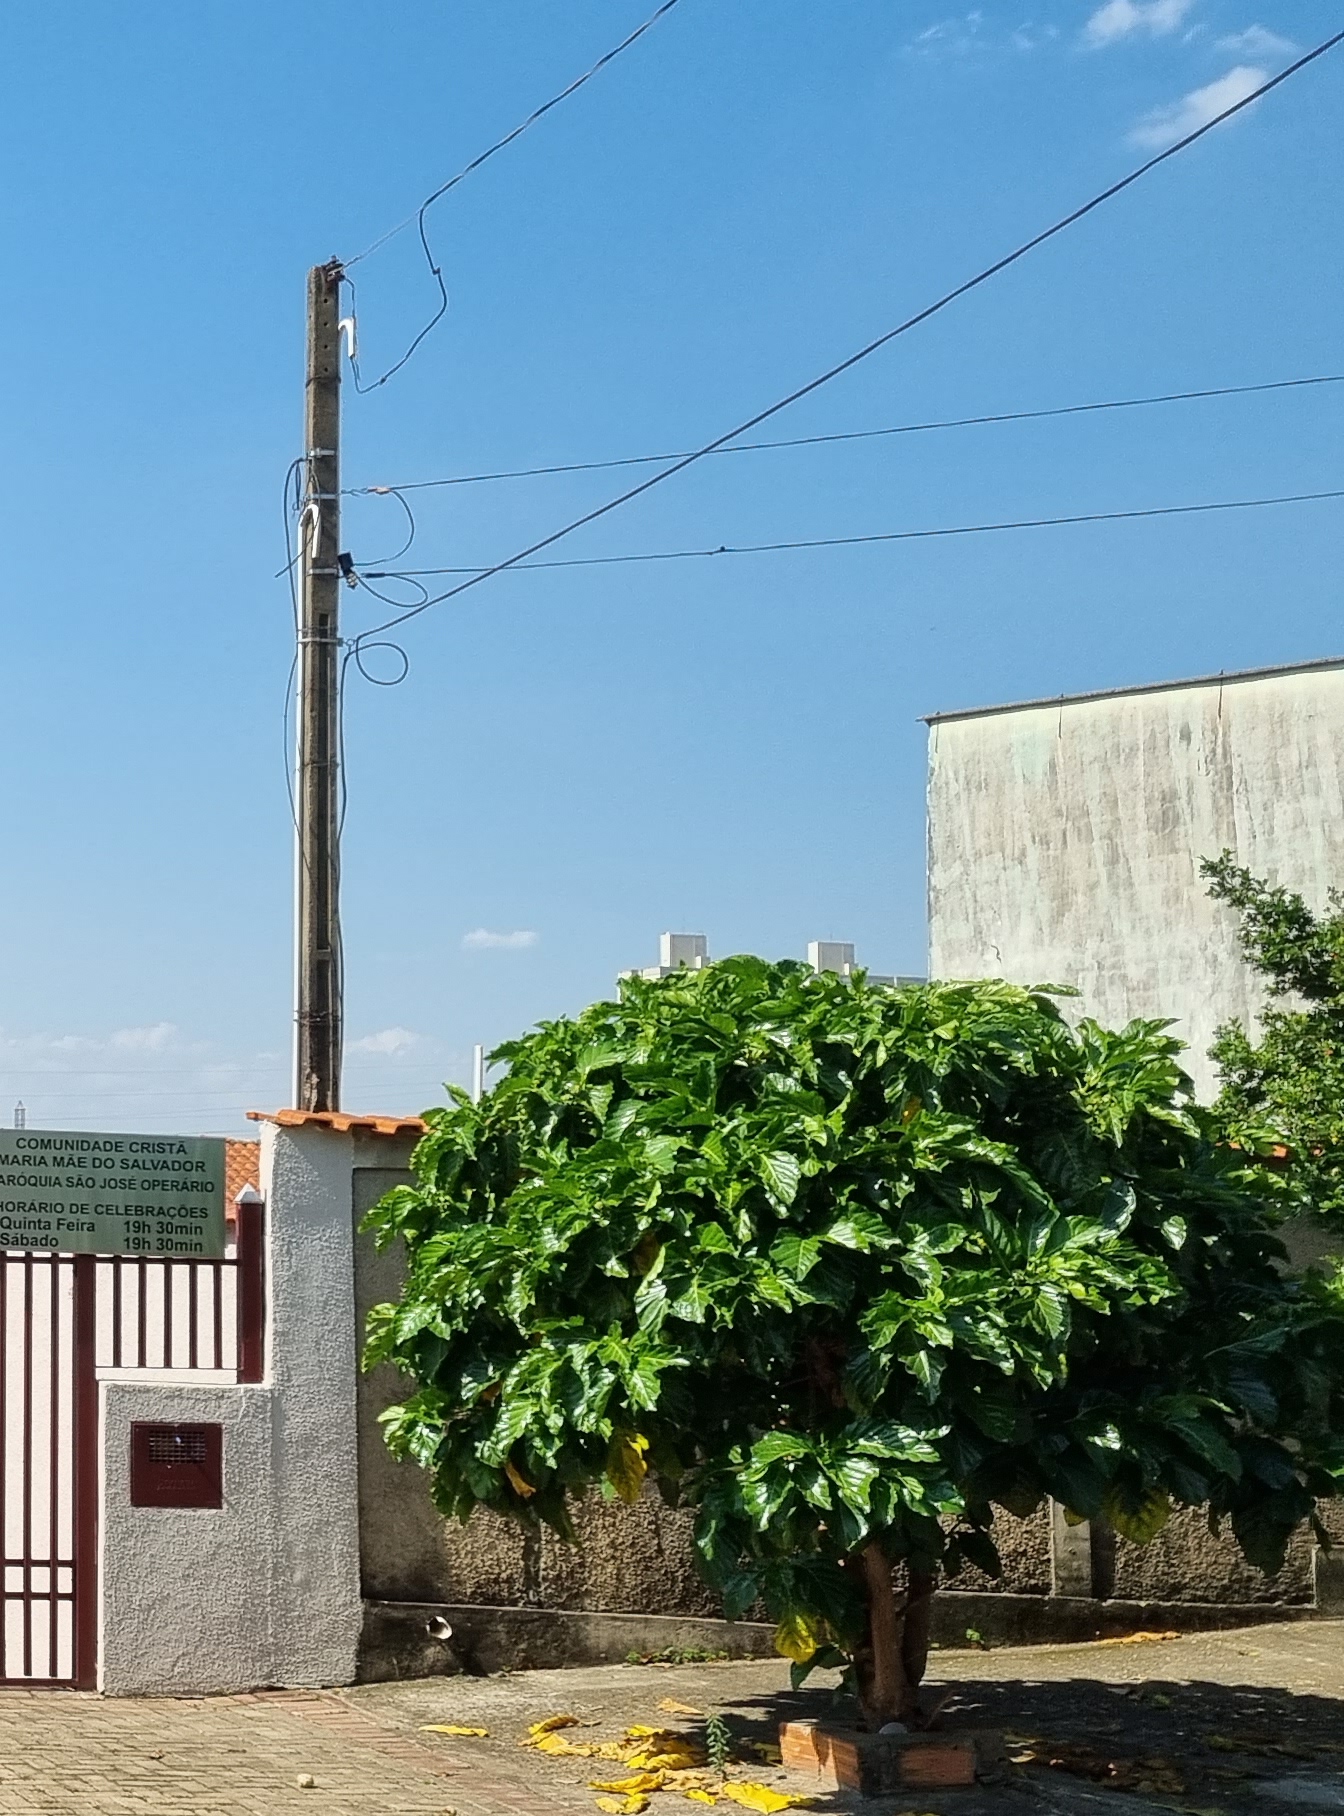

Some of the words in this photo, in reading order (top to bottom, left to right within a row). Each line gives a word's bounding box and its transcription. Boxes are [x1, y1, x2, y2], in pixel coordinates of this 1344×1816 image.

[16, 1137, 124, 1152] COMUNIDADE
[129, 1141, 187, 1155] CRISTÃ
[52, 1154, 88, 1168] MÃE
[92, 1157, 115, 1169] DO
[120, 1158, 206, 1172] SALVADOR
[66, 1174, 96, 1189] SÃO
[99, 1176, 137, 1190] JOSÉ
[141, 1178, 215, 1193] OPERÁRIO
[69, 1203, 90, 1215] DE
[94, 1204, 209, 1219] CELEBRAÇÕES
[0, 1216, 51, 1230] Quinta
[56, 1218, 96, 1232] Feira
[124, 1220, 151, 1234] 19h
[156, 1221, 203, 1236] 30min
[0, 1232, 59, 1247] Sábado
[124, 1236, 151, 1250] 19h
[156, 1237, 203, 1252] 30min
